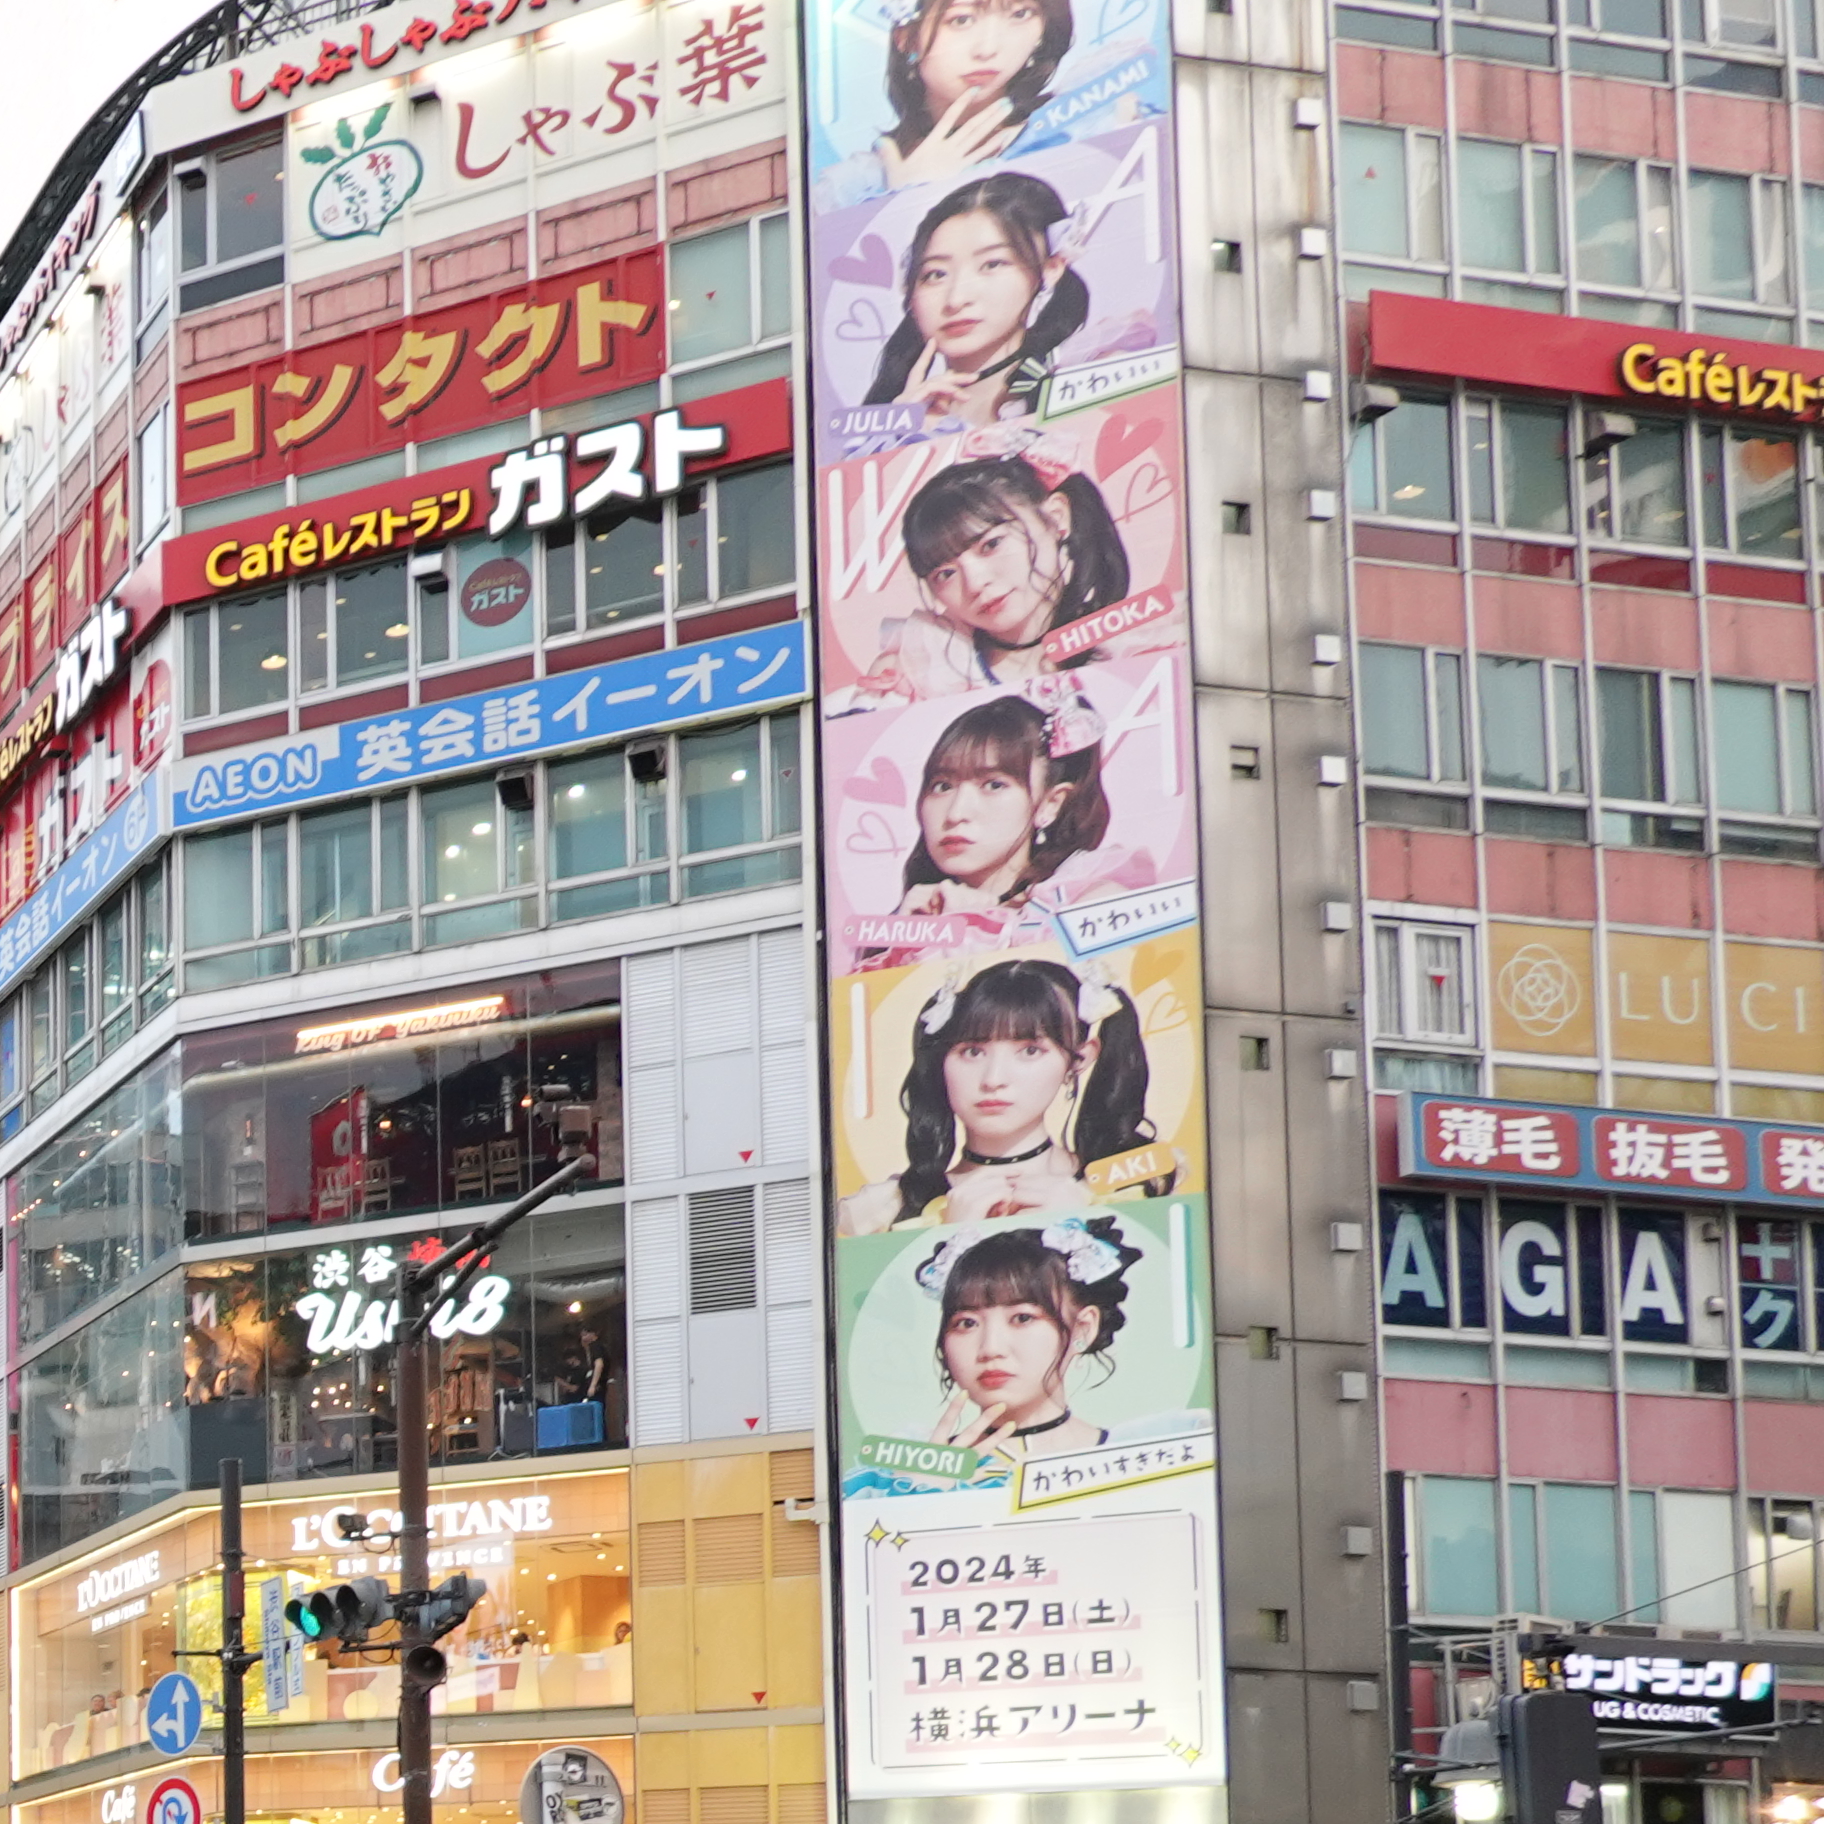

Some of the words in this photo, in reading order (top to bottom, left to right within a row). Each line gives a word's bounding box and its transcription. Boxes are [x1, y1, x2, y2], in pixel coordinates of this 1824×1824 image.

[456, 5, 767, 180] しゃぶ葉
[1045, 59, 1148, 131] KANAMI
[183, 281, 652, 475] コンタクト
[1058, 360, 1160, 401] かわいい
[840, 410, 913, 434] JULIA
[489, 410, 726, 534] ガスト
[470, 584, 525, 611] ガスト
[1060, 594, 1164, 654] HITOKA
[56, 600, 129, 728] ガスト
[192, 748, 319, 803] AEON
[857, 919, 956, 944] HARUKA
[1077, 897, 1182, 938] かわいい
[1437, 1106, 1562, 1172] 薄毛
[1608, 1121, 1731, 1184] 抜毛
[1107, 1152, 1157, 1185] AKI
[1381, 1210, 1685, 1325] AGA
[875, 1442, 966, 1475] HIYORI
[1032, 1442, 1195, 1493] かわいすぎだよ
[77, 1550, 160, 1612] L'OCCITANE
[337, 1558, 368, 1575] EN
[909, 1553, 1047, 1588] 2024年
[910, 1598, 1132, 1638] 1月27日(土)
[911, 1649, 1133, 1687] 1月28日(日)
[1563, 1653, 1738, 1698] サンドラッグ
[910, 1698, 1157, 1742] 横浜アリーナ
[1592, 1700, 1622, 1719] UG
[1637, 1702, 1722, 1725] COSMETIC
[371, 1750, 474, 1799] Cfé
